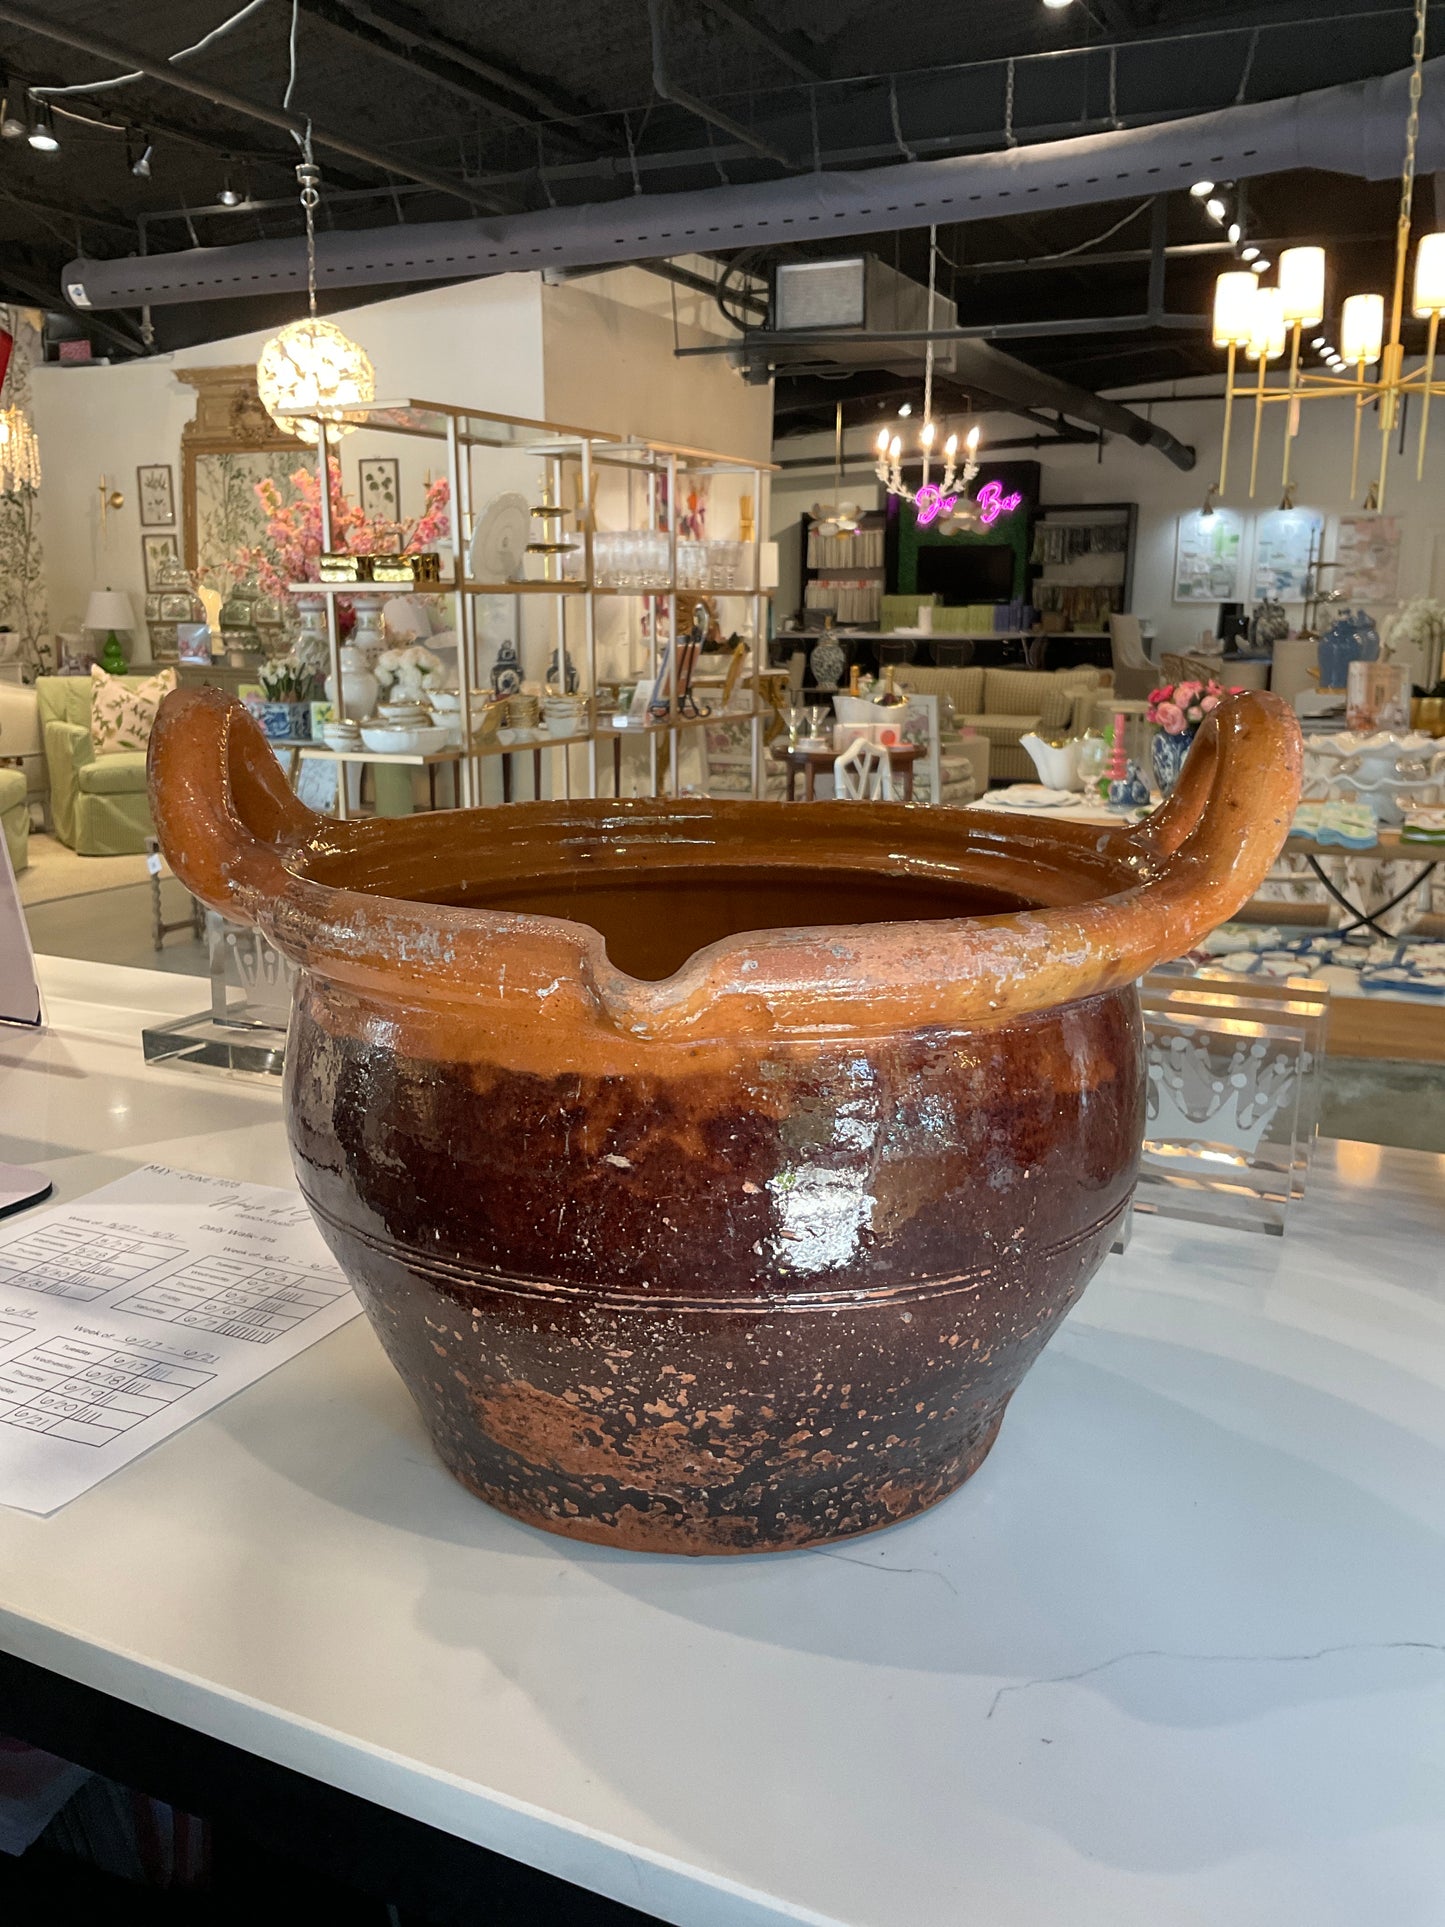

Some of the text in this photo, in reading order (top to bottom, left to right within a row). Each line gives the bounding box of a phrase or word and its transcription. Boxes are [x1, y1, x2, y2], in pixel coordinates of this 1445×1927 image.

[976, 480, 1022, 524] Bar
[144, 1164, 172, 1178] MAY
[180, 1172, 212, 1185] JUNE
[68, 1215, 91, 1224] Week
[199, 1224, 226, 1235] Daily
[222, 1246, 248, 1257] Week
[40, 1266, 71, 1278] 5/30
[264, 1269, 288, 1283] 6/3
[13, 1276, 44, 1288] 5/31
[247, 1279, 271, 1293] 6/4
[204, 1303, 238, 1316] 6/6
[183, 1315, 219, 1329] 6/7
[74, 1324, 100, 1337] Week
[61, 1344, 93, 1356] Tuesday
[124, 1335, 163, 1349] 6/17
[183, 1348, 221, 1363] 6/21
[32, 1355, 75, 1370] Wednesday
[113, 1355, 149, 1371] 6/17
[12, 1369, 47, 1382] Thursday
[85, 1369, 126, 1386] 6/18
[64, 1383, 105, 1399] 6/19
[39, 1396, 78, 1412] 6/20
[14, 1409, 50, 1427] 6/21
